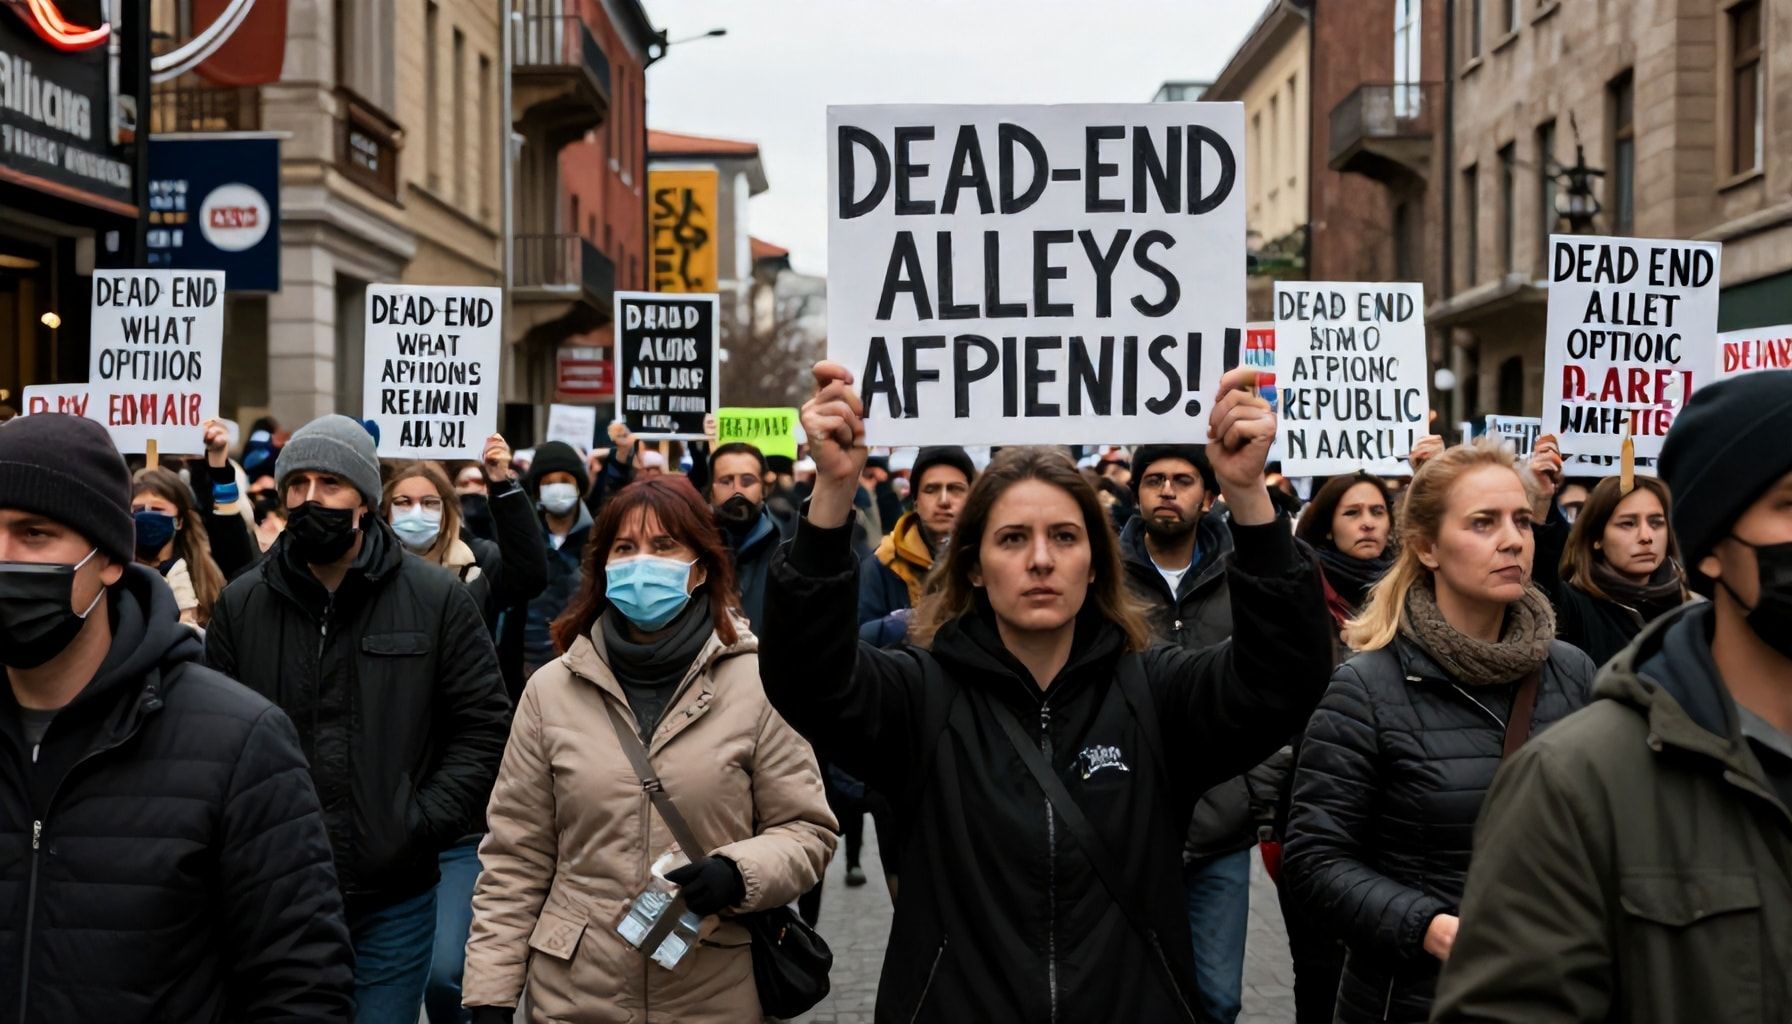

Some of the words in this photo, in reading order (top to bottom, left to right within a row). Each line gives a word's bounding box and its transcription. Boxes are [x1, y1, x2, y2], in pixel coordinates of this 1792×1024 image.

[838, 122, 1236, 219] DEAD-END
[876, 229, 1181, 320] ALLEYS
[1554, 242, 1639, 284] DEAD
[1649, 247, 1714, 287] END
[96, 277, 160, 307] DEAD
[172, 277, 217, 308] END
[1279, 291, 1346, 321] DEAD
[1358, 292, 1414, 322] END
[372, 294, 435, 326] DEAD
[445, 296, 493, 327] END
[121, 316, 195, 345] WHAT
